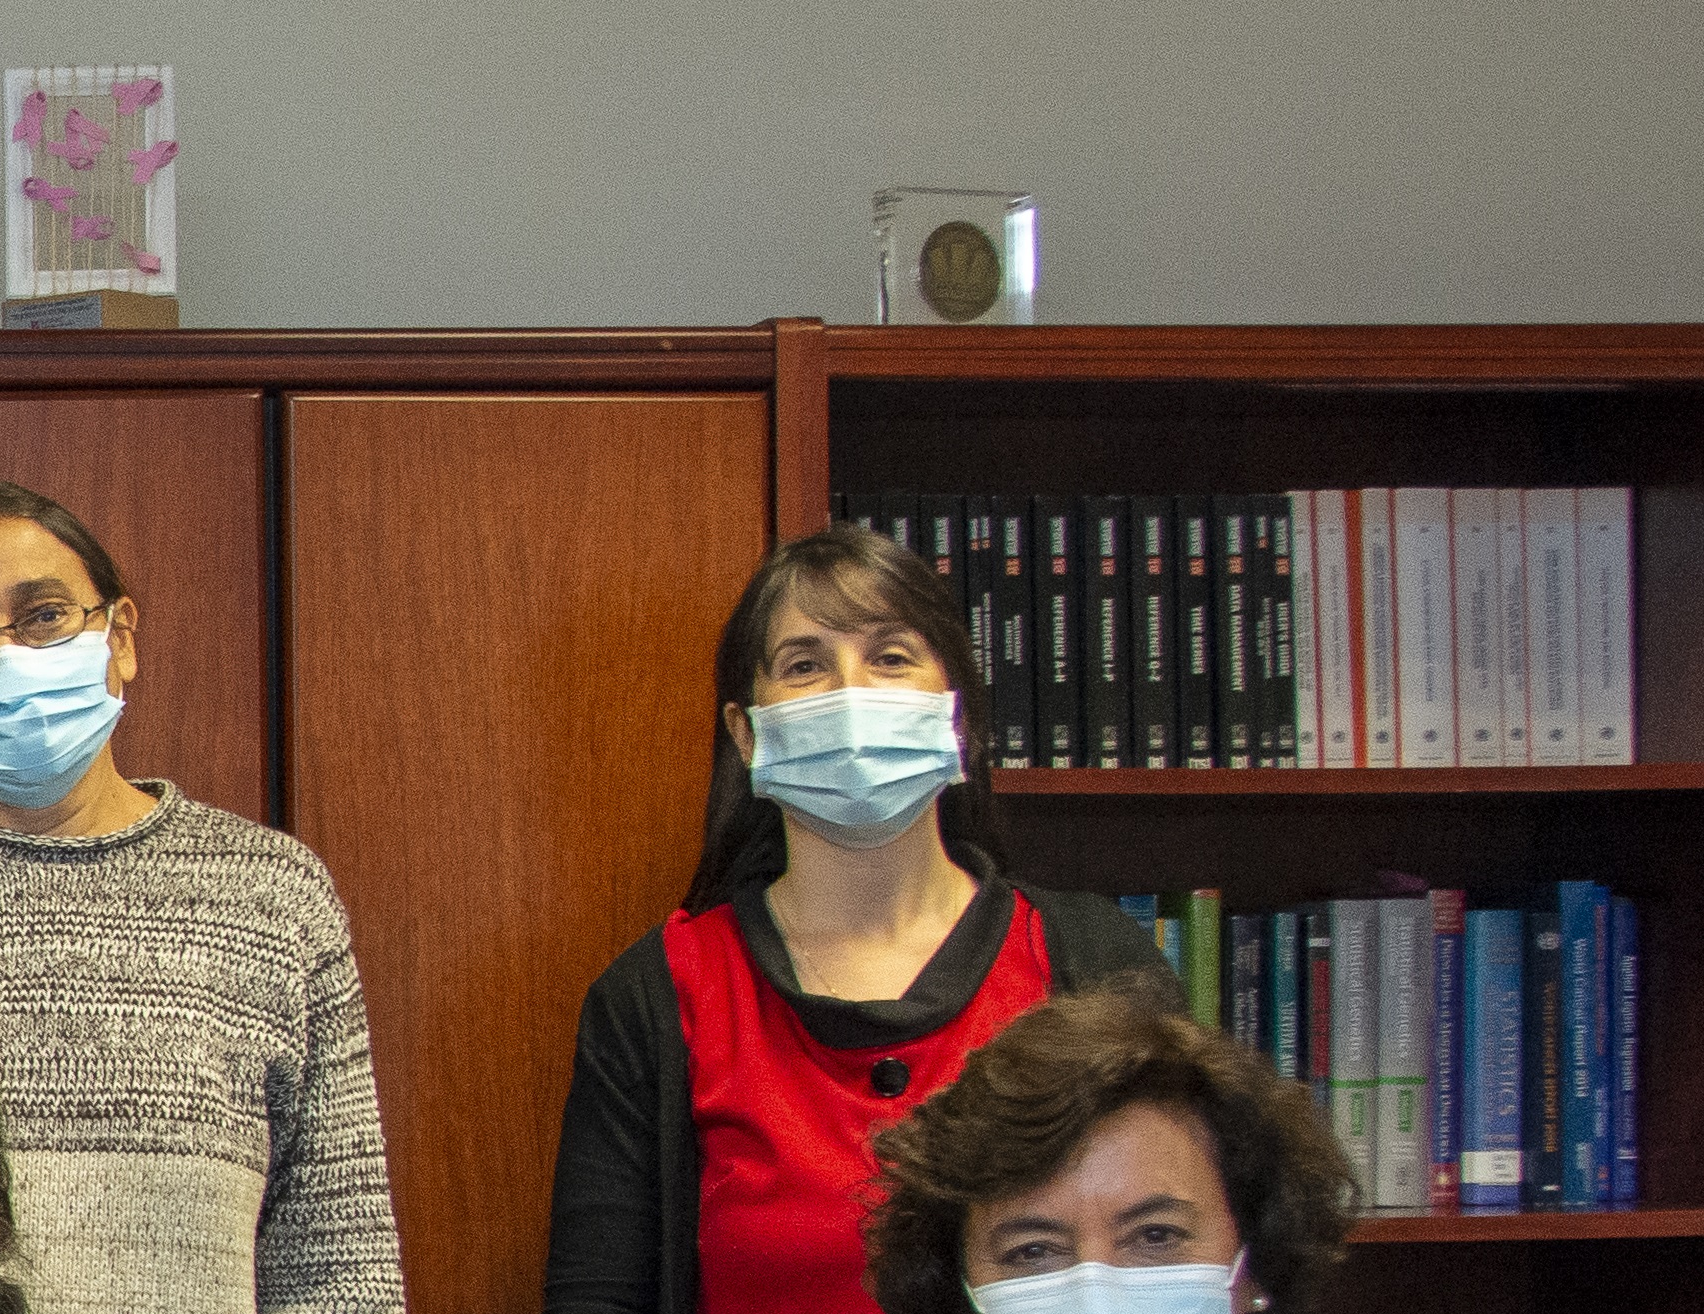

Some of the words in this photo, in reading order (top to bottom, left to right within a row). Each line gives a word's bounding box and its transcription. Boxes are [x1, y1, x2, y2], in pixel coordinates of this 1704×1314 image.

[1230, 584, 1244, 612] DATA
[971, 607, 982, 645] SURVEY
[1052, 595, 1066, 658] REFERENCE
[1101, 598, 1114, 661] REFERENCE
[1147, 596, 1161, 658] REFERENCE
[1190, 606, 1204, 633] TIME
[1276, 602, 1290, 642] USER'S
[1053, 660, 1066, 683] A-H
[1102, 664, 1115, 682] I-P
[1148, 660, 1162, 682] Q-Z
[1191, 636, 1205, 675] SERIES
[1230, 614, 1245, 692] MANAGEMENT
[1277, 644, 1290, 676] GUIDE
[1349, 920, 1364, 993] Statistical
[1398, 917, 1414, 989] Statistical
[1573, 938, 1587, 973] World
[1621, 954, 1636, 993] Applied
[1543, 983, 1555, 1021] WORLD
[1573, 977, 1587, 1021] Cancer
[1621, 995, 1636, 1033] Logistic
[1280, 1001, 1296, 1049] SURVIVAL
[1348, 995, 1364, 1061] Genetics
[1397, 992, 1412, 1058] Genetics
[1573, 1024, 1587, 1066] Report
[1439, 1022, 1453, 1091] MOLECULAR
[1498, 990, 1520, 1116] STATISTICS
[1543, 1026, 1556, 1075] CANCER
[1622, 1037, 1636, 1091] Regression
[1544, 1078, 1557, 1120] REPORT
[1574, 1070, 1588, 1098] 2014
[1438, 1094, 1453, 1159] ONCOLOGY
